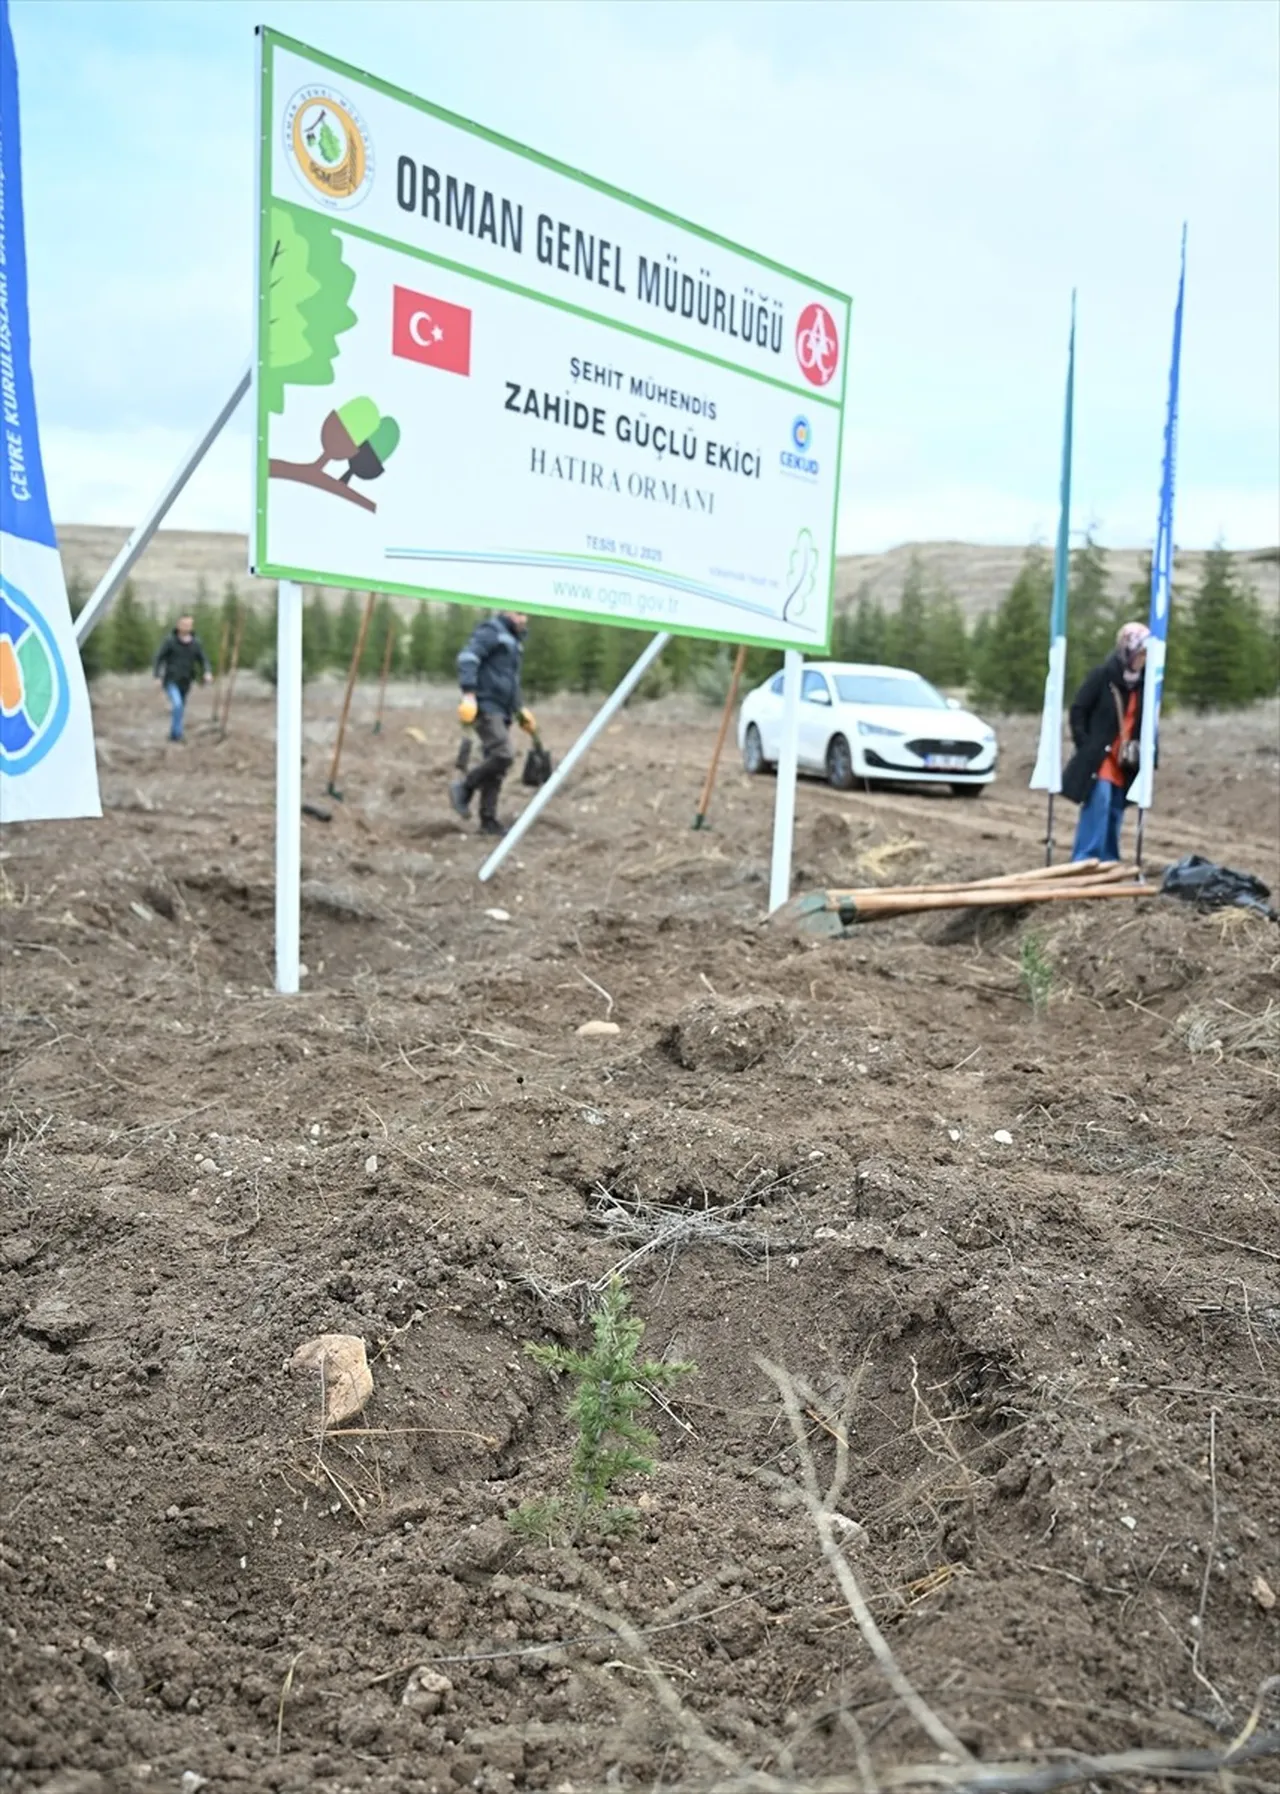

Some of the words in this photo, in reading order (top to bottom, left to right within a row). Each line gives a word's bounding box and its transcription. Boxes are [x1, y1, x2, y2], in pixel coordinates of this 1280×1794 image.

[396, 155, 524, 254] ORMAN
[536, 213, 627, 294] GENEL
[637, 254, 784, 355] MÜDÜRLÜĞÜ
[569, 356, 624, 391] ŞEHİT
[629, 375, 718, 421] MÜHENDİS
[503, 381, 607, 436] ZAHİDE
[615, 411, 698, 462] GÜÇLÜ
[705, 440, 762, 480] EKİCİ
[5, 430, 33, 502] ÇEVRE
[529, 446, 622, 494] HATIRA
[627, 472, 716, 515] ORMANI
[552, 579, 679, 615] www.ogm.gov.tr
